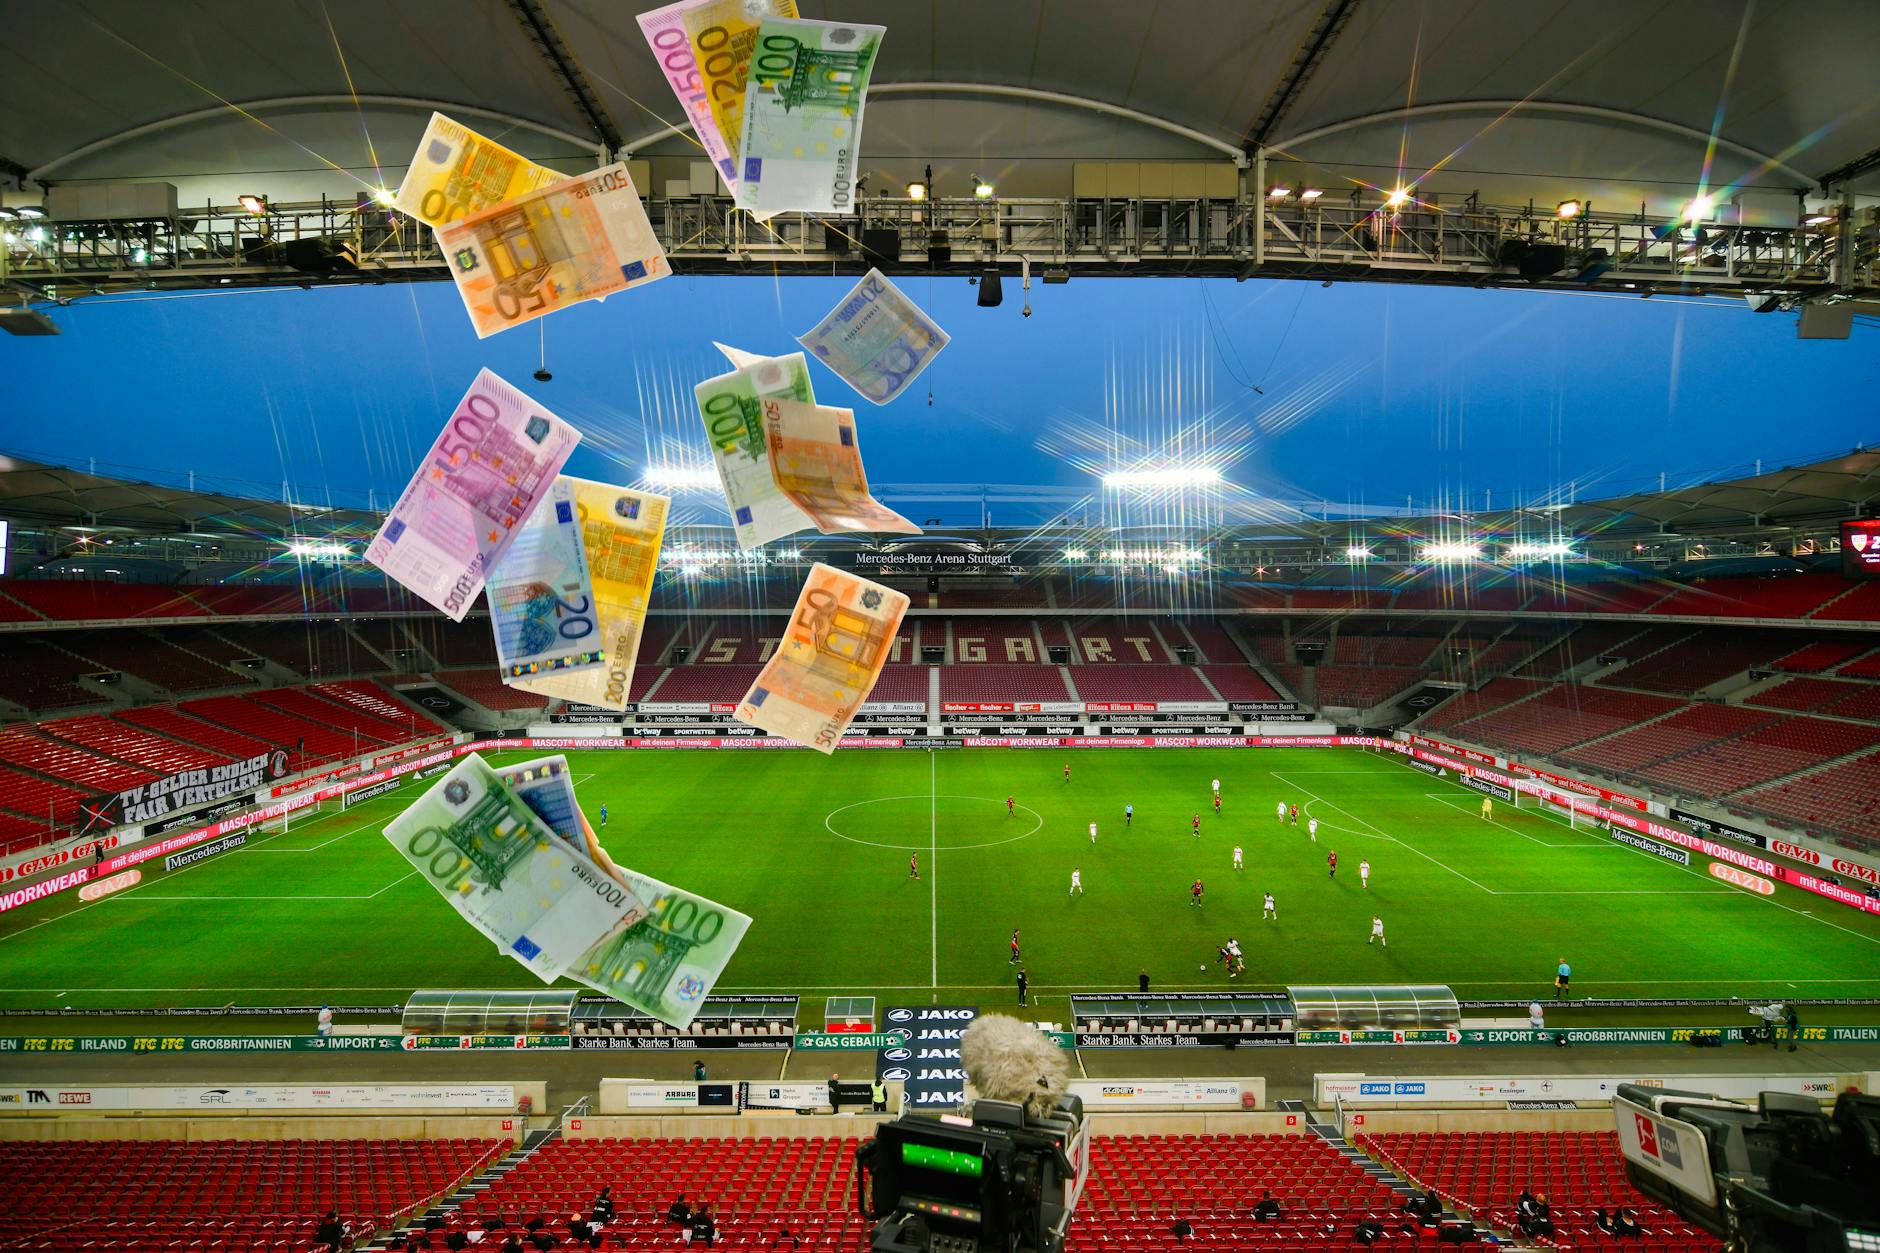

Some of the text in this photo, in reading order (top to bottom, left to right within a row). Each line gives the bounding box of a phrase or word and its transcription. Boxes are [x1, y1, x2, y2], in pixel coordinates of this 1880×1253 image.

[856, 552, 1012, 567] Mercedes-Benz Arena Stuttgart
[945, 703, 967, 711] fischer
[979, 703, 1002, 711] fischer
[1177, 714, 1221, 722] Mercedes-Benz
[728, 727, 756, 736] betway
[889, 727, 916, 736] betway
[953, 727, 981, 736] betway
[1000, 727, 1028, 736] betway
[1047, 727, 1075, 736] betway
[1112, 727, 1139, 736] betway
[1205, 726, 1233, 735] betway
[575, 739, 625, 747] WORKWEAR
[676, 739, 711, 748] Firmenlogo
[864, 738, 899, 747] Firmenlogo
[905, 738, 946, 746] Mercedes-Benz
[1009, 738, 1059, 746] WORKWEAR
[1110, 738, 1145, 747] Firmenlogo
[1196, 737, 1247, 746] WORKWEAR
[1296, 737, 1331, 746] Firmenlogo
[421, 749, 454, 766] WORKWEAR
[120, 770, 208, 807] TV-GELDER
[211, 753, 268, 784] ENDLICH
[124, 770, 264, 824] FAIR VERTEILEN!
[350, 780, 401, 804] Mercedes-Benz
[266, 793, 315, 819] WORKWEAR
[112, 829, 208, 869] mit deinem Firmenlogo
[1612, 828, 1686, 863] Mercedes-Benz
[170, 835, 246, 869] Mercedes-Benz
[1776, 842, 1818, 864] GAZI
[1702, 840, 1775, 877] WORKWEAR
[22, 853, 66, 876] GAZI
[571, 865, 598, 888] EURO
[1715, 865, 1769, 894] GAZI
[1800, 875, 1862, 905] mit deinem
[918, 1010, 975, 1020] JAKO
[1488, 1031, 1534, 1042] EXPORT
[1568, 1030, 1666, 1041] GROßBRITANNIEN
[1803, 1028, 1827, 1040] ITC
[1833, 1028, 1878, 1040] ITALIEN
[23, 1038, 48, 1051] ITC
[50, 1038, 75, 1051] ITC
[81, 1039, 127, 1050] IRLAND
[133, 1038, 157, 1050] ITC
[161, 1038, 185, 1050] ITC
[191, 1038, 292, 1050] GROßBRITANNIEN
[328, 1038, 377, 1049] IMPORT
[579, 1037, 698, 1049] Starke Bank. Starkes Team.
[815, 1037, 884, 1048] GAS GEBA!!!
[1082, 1034, 1200, 1046] Starke Bank. Starkes Team.
[1405, 1084, 1424, 1092] JAKO
[1499, 1087, 1526, 1095] Ensinger
[60, 1093, 91, 1103] REWE
[665, 1090, 696, 1098] ARBURG
[1510, 1102, 1576, 1110] Mercedes-Benz Bank
[502, 1121, 511, 1129] 11
[572, 1121, 581, 1129] 10
[1288, 1116, 1294, 1124] 9
